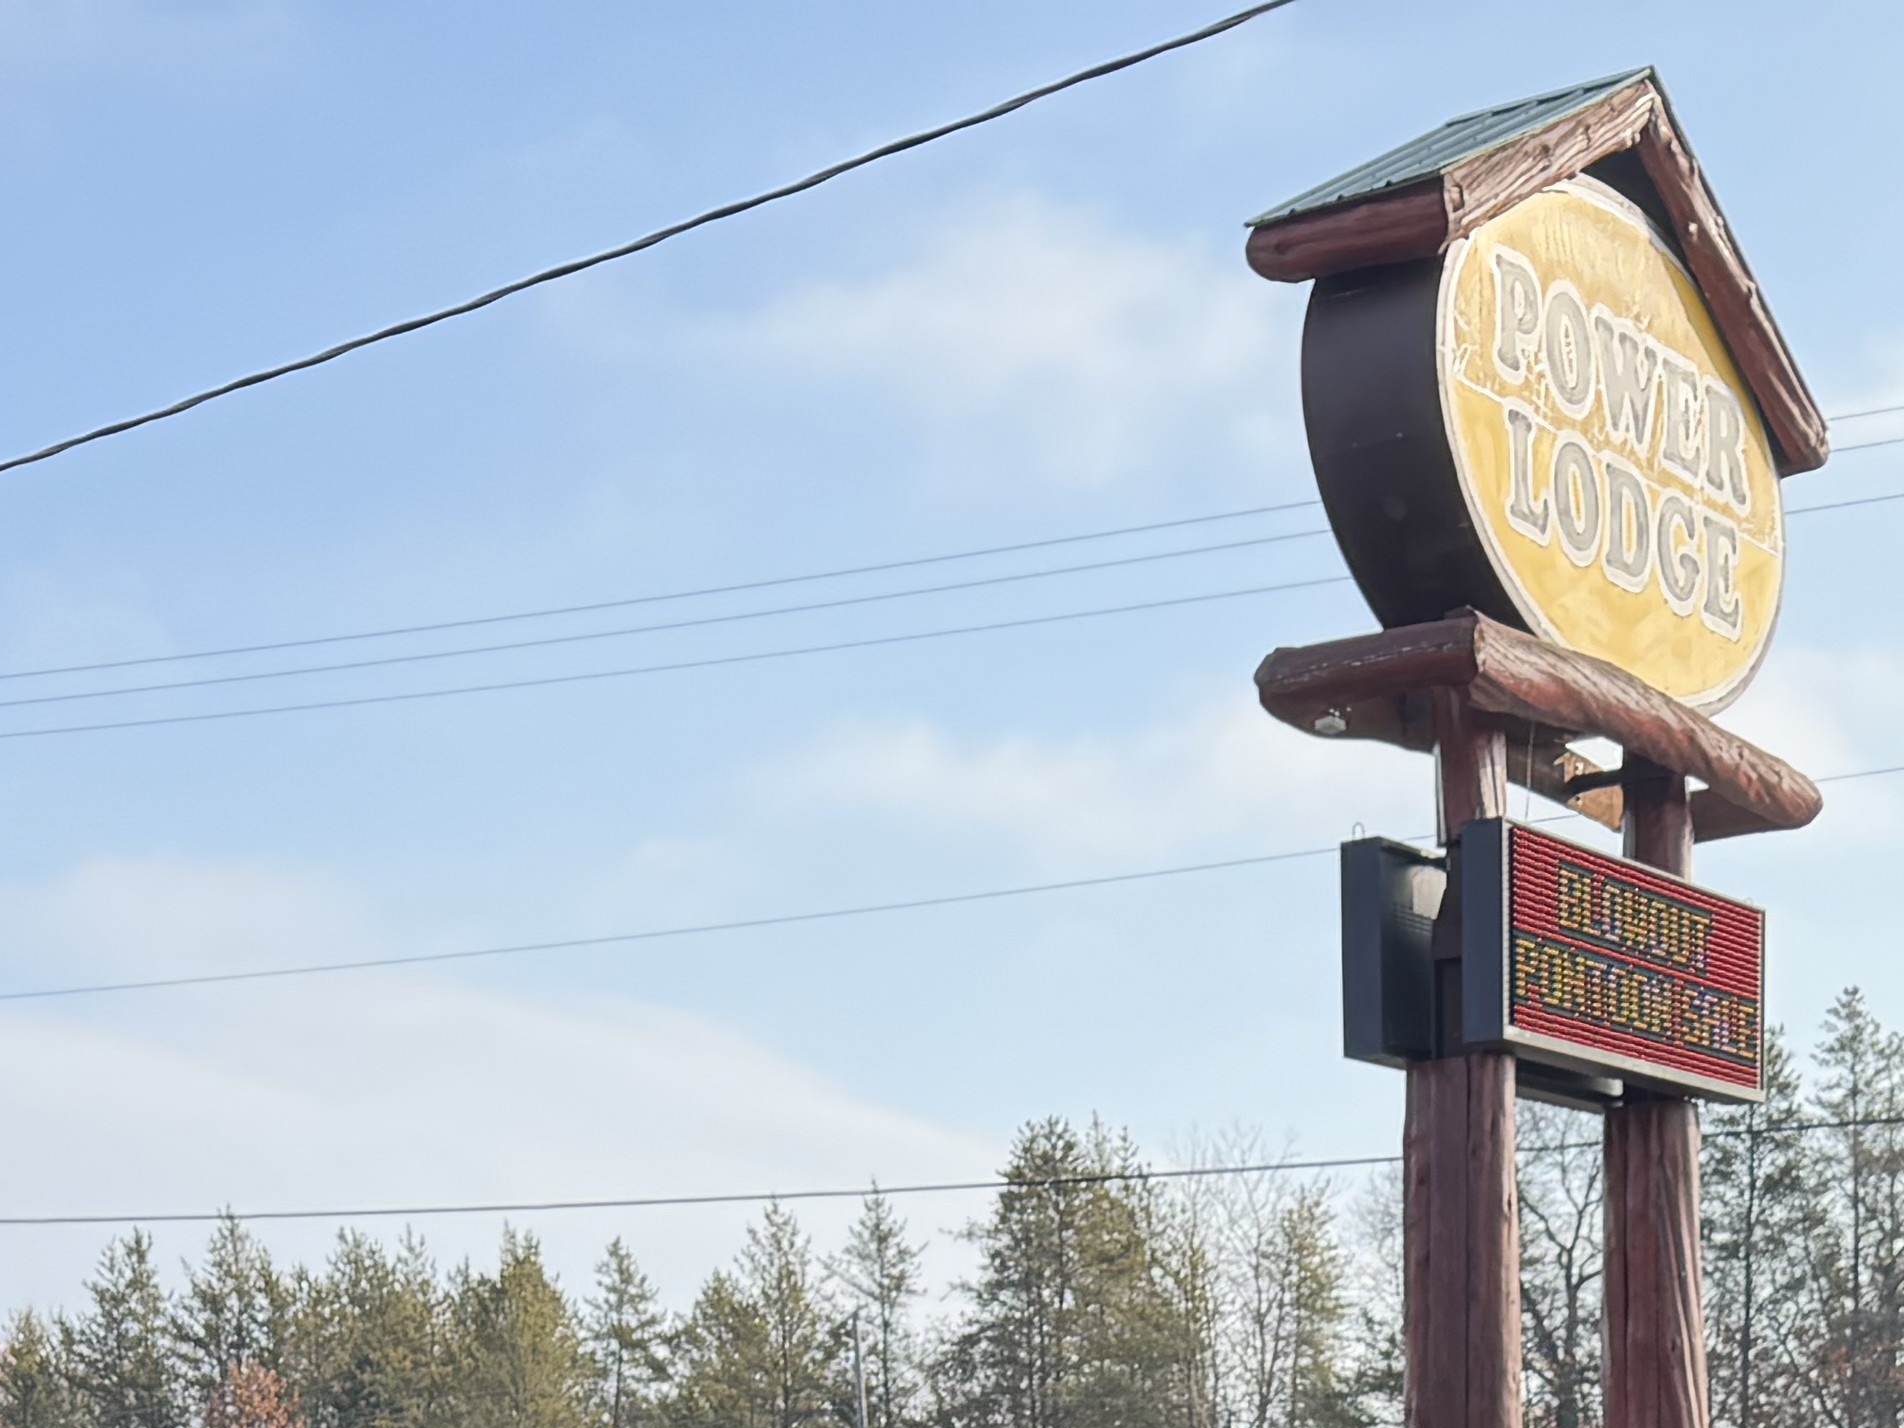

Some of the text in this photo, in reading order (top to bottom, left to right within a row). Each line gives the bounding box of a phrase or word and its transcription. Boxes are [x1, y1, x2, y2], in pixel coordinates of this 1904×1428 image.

[1492, 246, 1749, 512] POWER
[1505, 400, 1743, 638] LODGE
[1515, 938, 1756, 1060] PONTOON SALE
[1559, 866, 1713, 974] BLOWOUT
